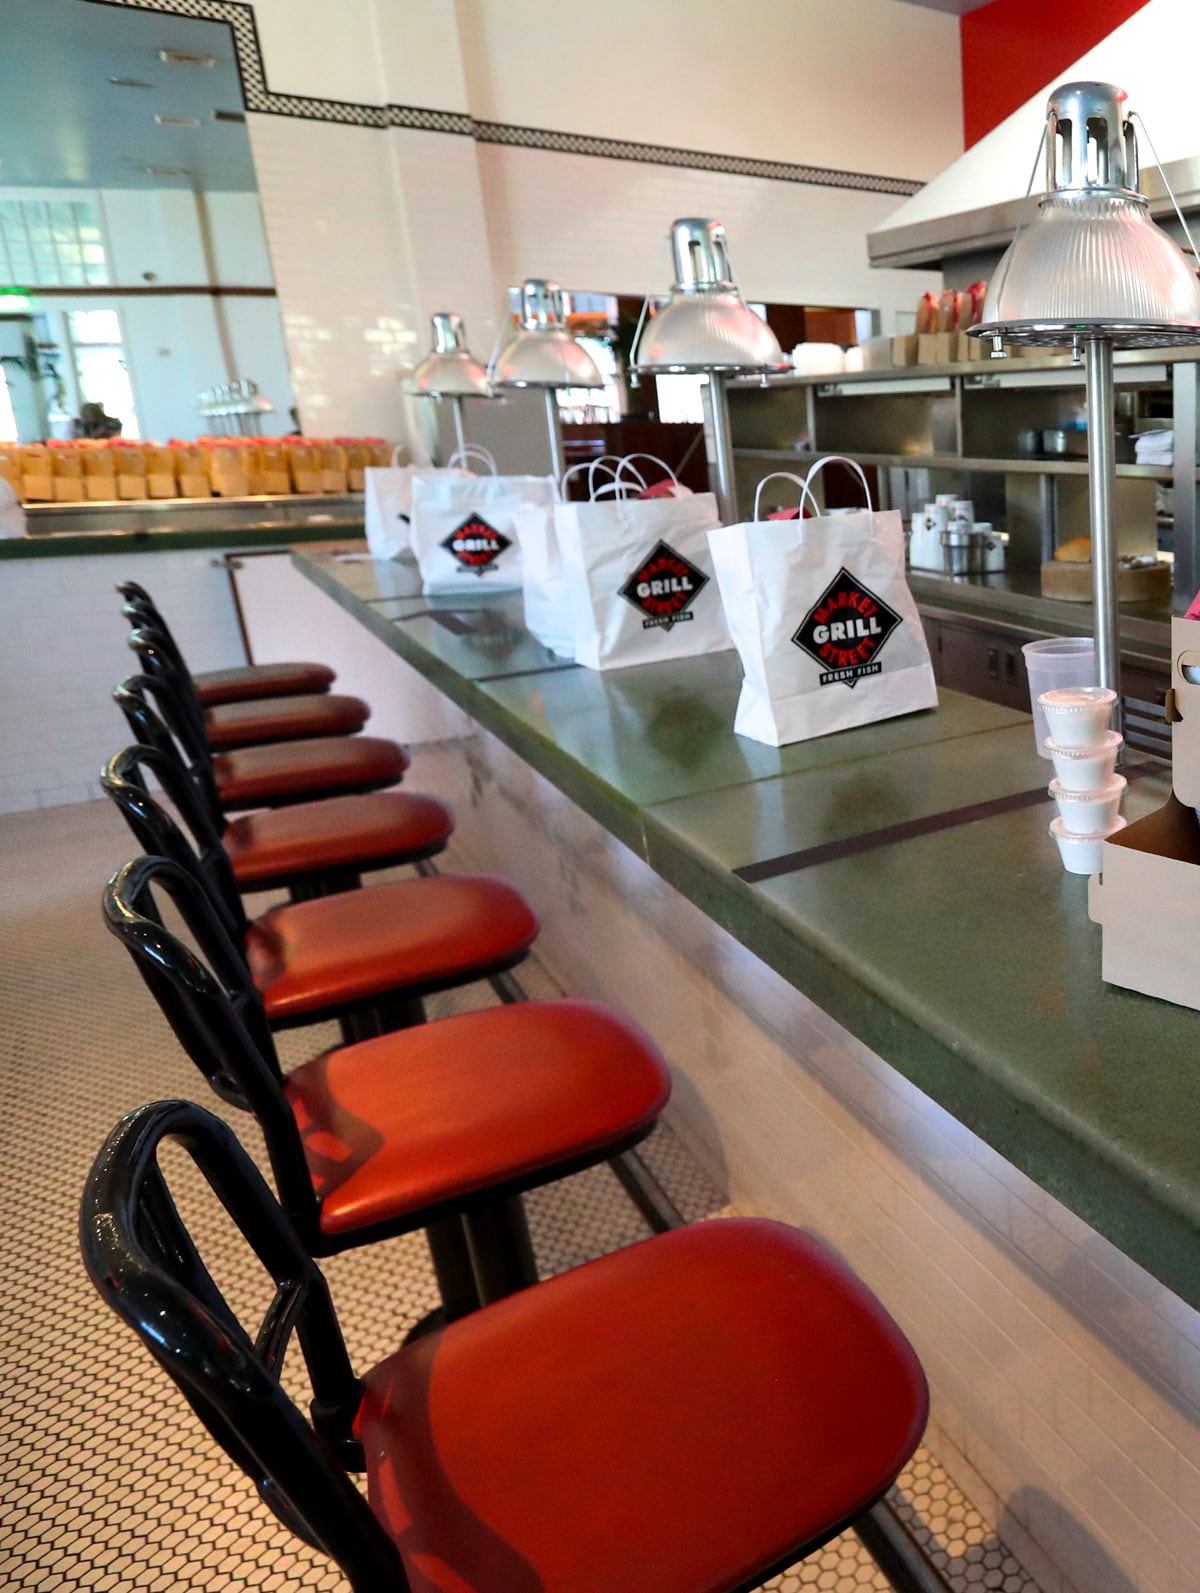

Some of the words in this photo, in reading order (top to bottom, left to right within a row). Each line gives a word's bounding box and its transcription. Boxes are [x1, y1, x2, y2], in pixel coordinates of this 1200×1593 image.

[452, 539, 499, 552] GRILL
[636, 576, 694, 598] GRILL
[812, 591, 879, 624] MARKET
[813, 616, 882, 645] GRILL
[819, 637, 877, 666] STREET
[822, 669, 854, 683] FRESH
[857, 664, 880, 677] FISH
